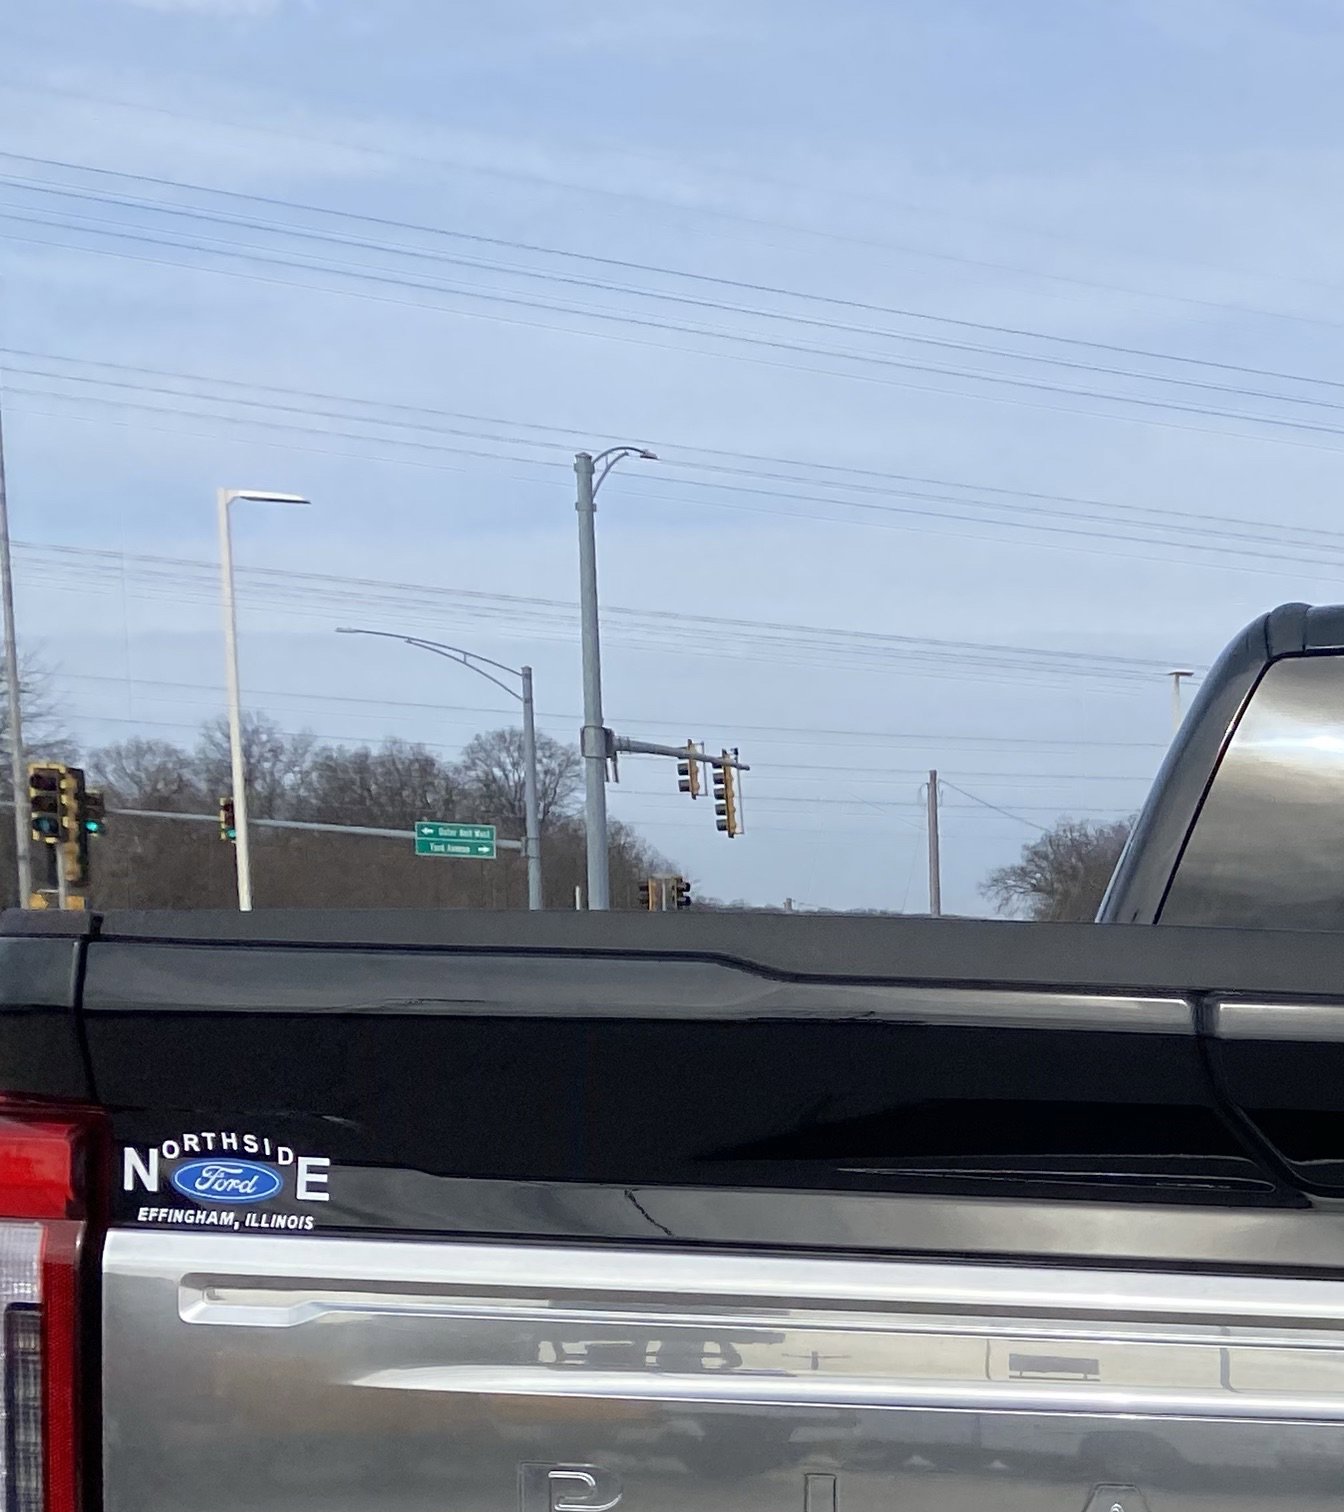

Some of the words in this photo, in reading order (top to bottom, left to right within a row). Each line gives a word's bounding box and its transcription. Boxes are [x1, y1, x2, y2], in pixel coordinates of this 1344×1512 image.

[123, 1132, 331, 1201] NORTHSIDE
[195, 1165, 259, 1194] Ford
[137, 1206, 240, 1230] EFFINGHAM,
[244, 1212, 315, 1230] ILLINOIS
